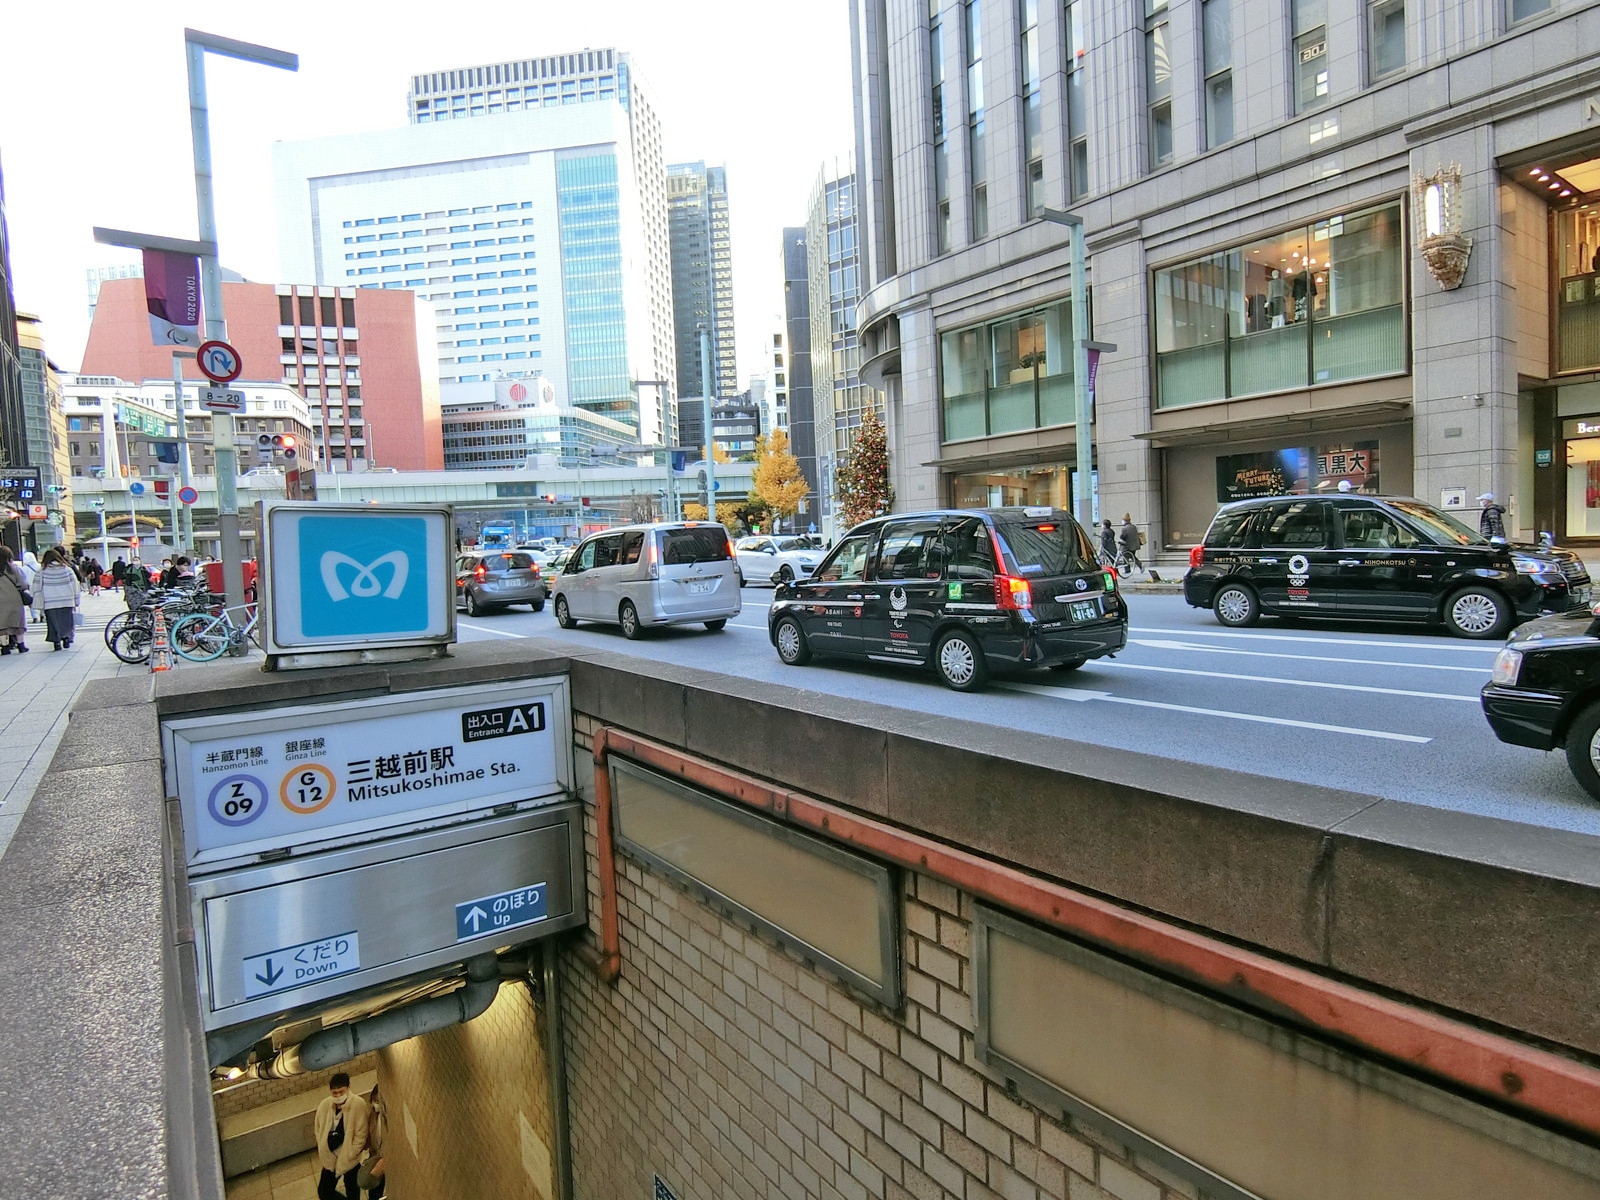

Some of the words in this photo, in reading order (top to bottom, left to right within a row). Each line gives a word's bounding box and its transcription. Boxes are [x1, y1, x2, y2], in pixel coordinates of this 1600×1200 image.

[186, 276, 196, 302] TOKYO
[187, 302, 197, 322] 2020
[1235, 469, 1258, 483] MERRY
[468, 712, 504, 729] 出入口
[506, 705, 541, 733] A1
[468, 727, 504, 739] Entrance
[285, 737, 326, 753] 銀座線
[206, 746, 264, 764] 半蔵門線
[285, 752, 308, 761] Ginza
[310, 749, 327, 757] Line
[202, 762, 249, 774] Hanzomon
[251, 758, 269, 767] Line
[346, 745, 455, 784] 三越前駅
[300, 771, 316, 786] G
[348, 768, 485, 802] Mitsukoshimae
[490, 762, 521, 776] Sta.
[231, 782, 245, 798] Z
[297, 786, 323, 803] 12
[224, 797, 254, 816] 09
[492, 889, 540, 914] のぼり
[493, 913, 511, 927] Up
[293, 938, 349, 964] くだり
[295, 961, 338, 980] Down
